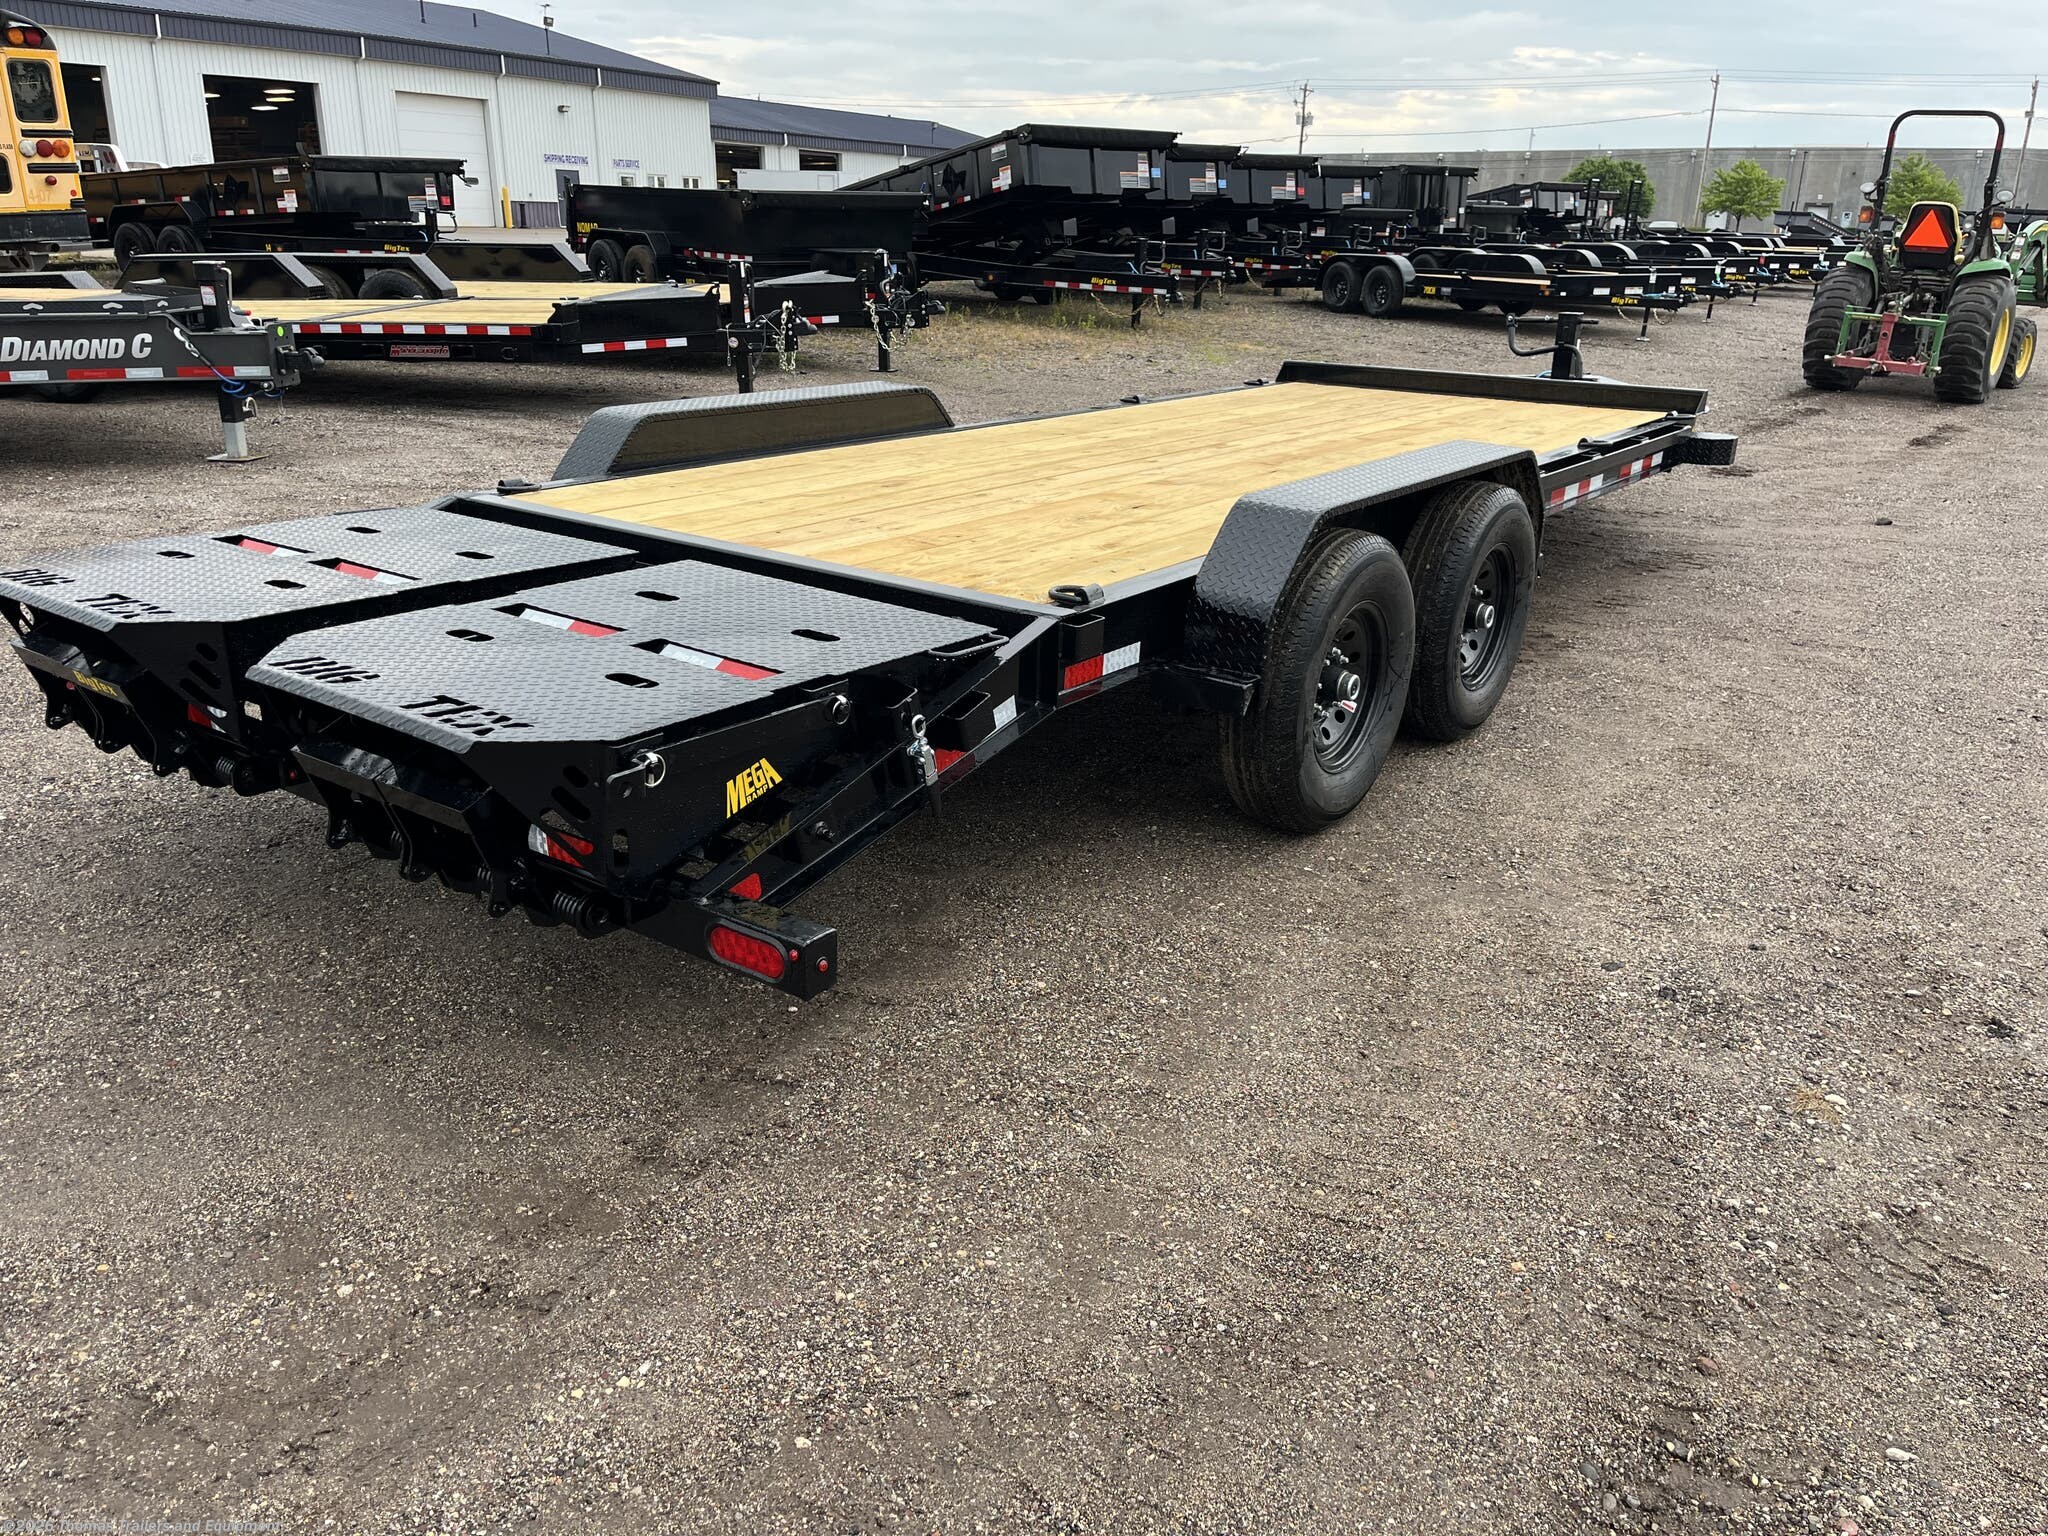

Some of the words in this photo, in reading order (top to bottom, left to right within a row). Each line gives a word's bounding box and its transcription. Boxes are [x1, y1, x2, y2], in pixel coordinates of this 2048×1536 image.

[543, 153, 564, 163] SHIPPING
[565, 155, 589, 165] RECEIVING
[384, 243, 410, 252] BigTex
[1091, 276, 1117, 286] BigTex
[1611, 296, 1639, 305] BigTex
[0, 336, 126, 362] DIAMOND
[131, 333, 153, 359] C
[75, 593, 175, 620] TEX
[72, 670, 118, 697] BigTex
[267, 656, 381, 684] BIG
[400, 694, 535, 737] TEX
[726, 757, 783, 819] MEGA
[746, 784, 769, 804] RAMP
